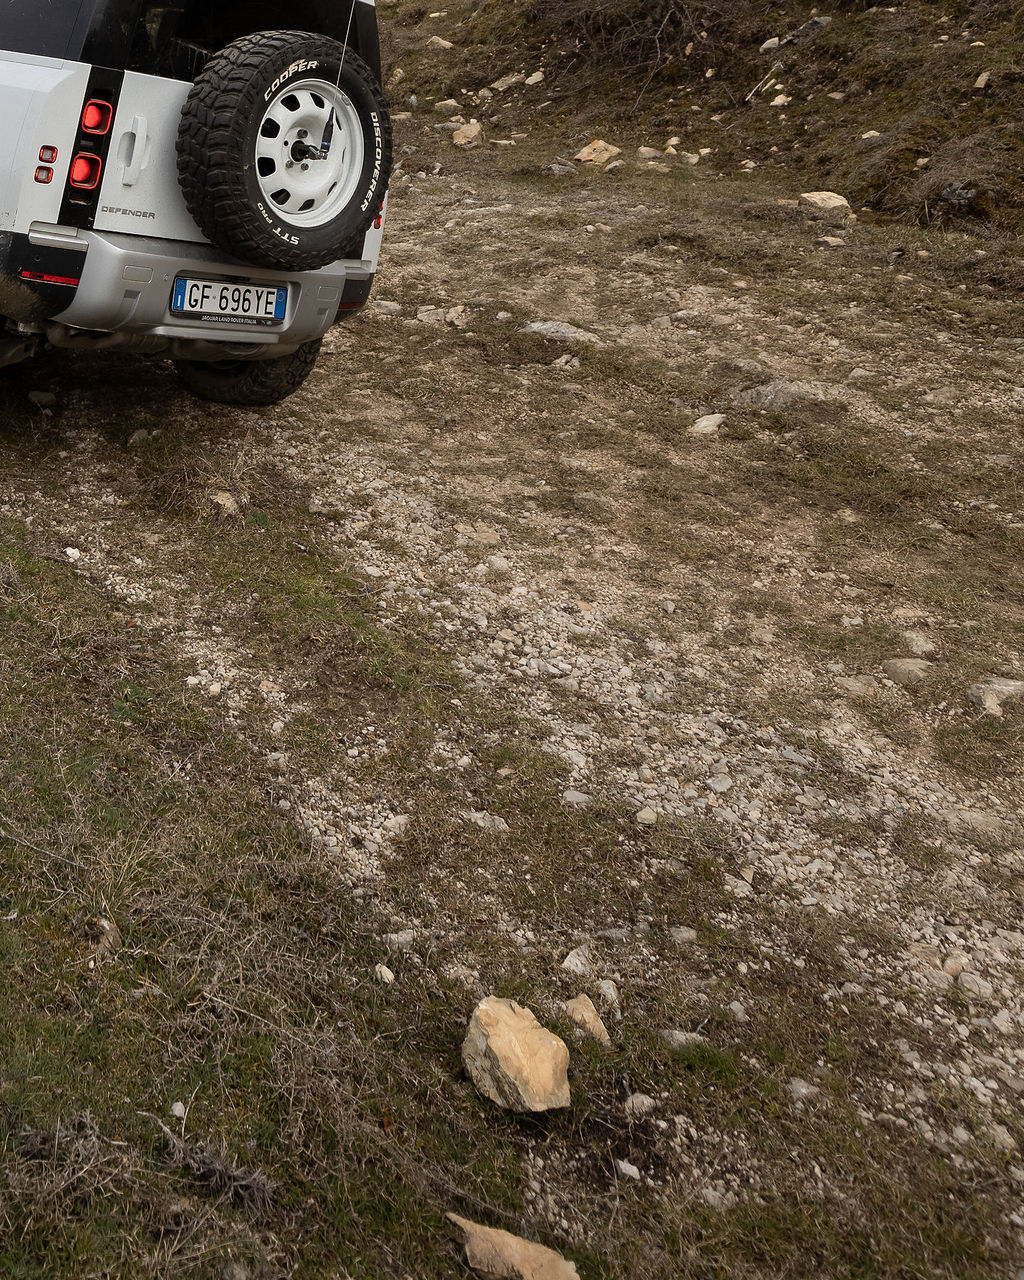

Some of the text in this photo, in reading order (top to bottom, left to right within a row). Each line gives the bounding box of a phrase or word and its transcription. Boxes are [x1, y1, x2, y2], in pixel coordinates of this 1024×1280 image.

[263, 59, 319, 102] COOPER
[360, 111, 384, 212] DISCOVERER
[101, 206, 156, 219] DEFENDER
[257, 202, 300, 246] STT PRO
